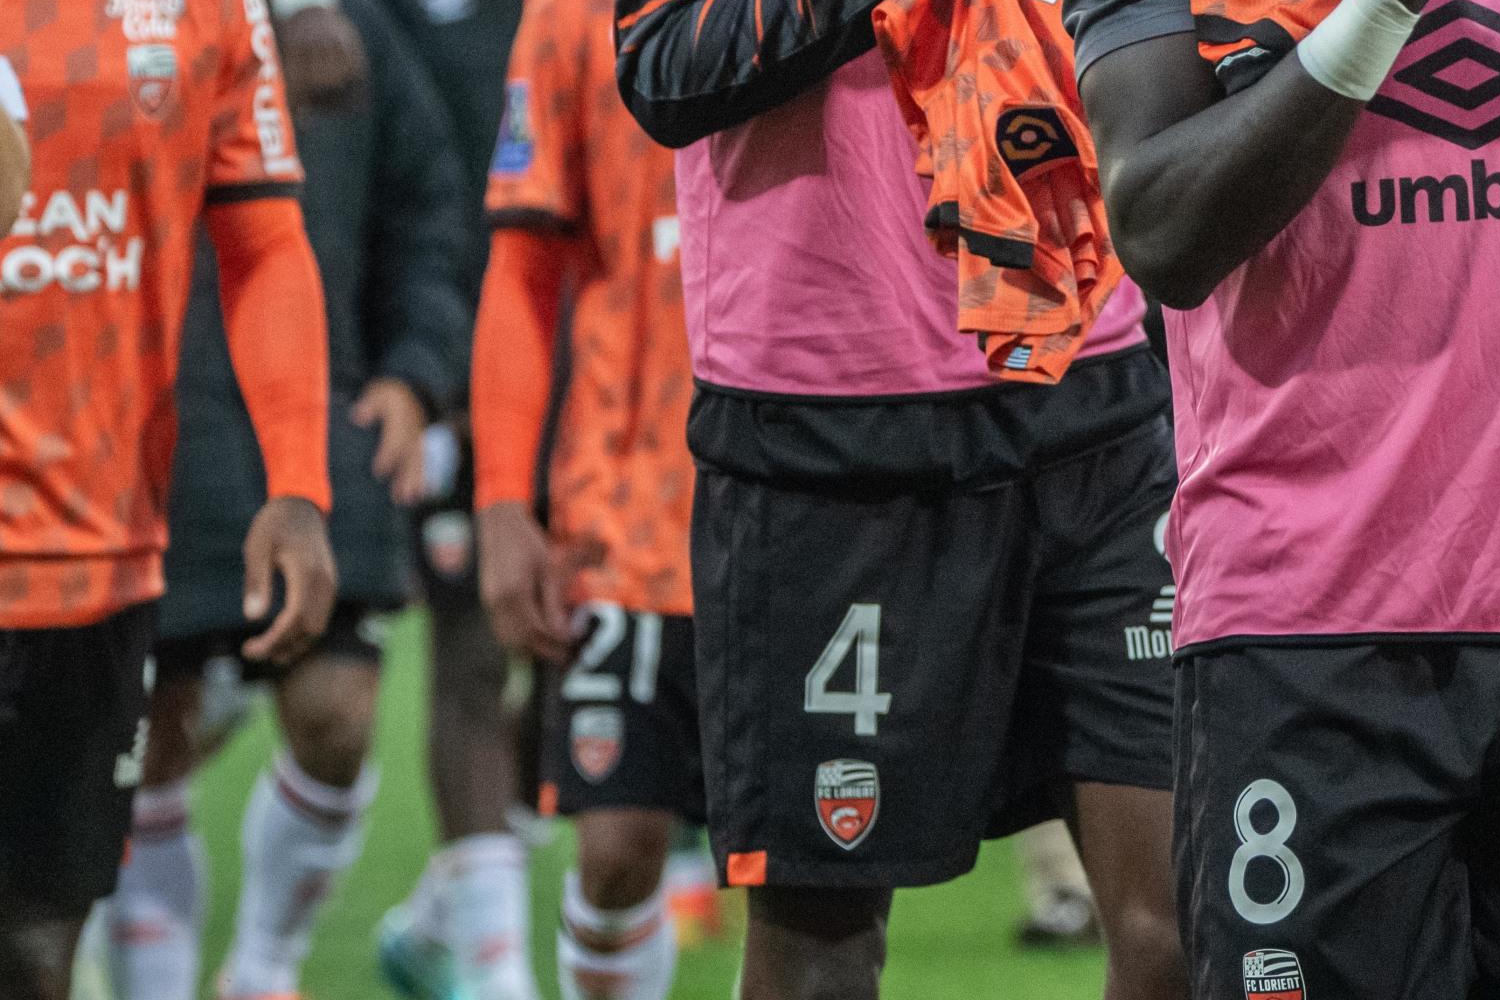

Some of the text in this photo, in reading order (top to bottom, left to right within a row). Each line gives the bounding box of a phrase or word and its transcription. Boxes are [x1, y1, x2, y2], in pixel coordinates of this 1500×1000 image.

[11, 189, 129, 242] AN
[0, 236, 145, 293] OC'H
[562, 600, 664, 704] 21
[804, 603, 892, 736] 4
[1228, 778, 1305, 925] 8
[1246, 976, 1301, 992] FC LORIENT
